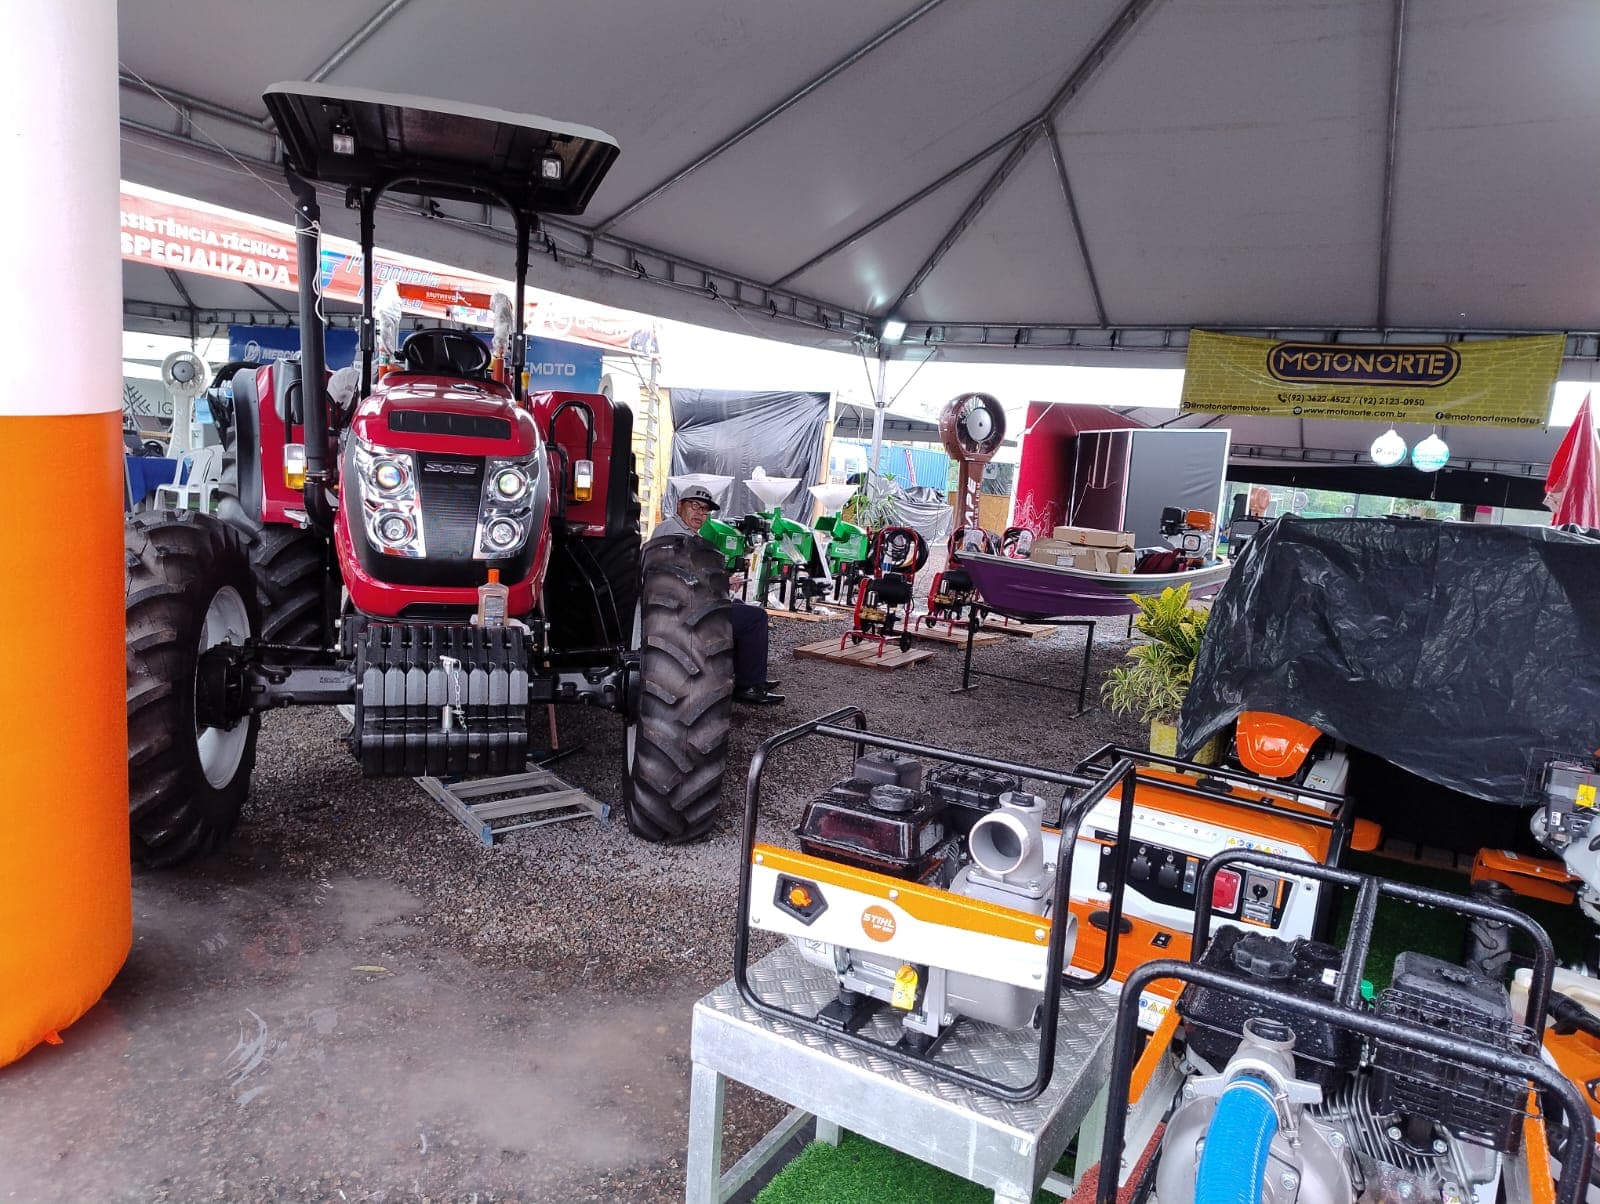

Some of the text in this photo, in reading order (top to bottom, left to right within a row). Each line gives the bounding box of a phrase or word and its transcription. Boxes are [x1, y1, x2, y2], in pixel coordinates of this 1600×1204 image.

[120, 211, 289, 262] SSISTÊNCIA TÉCNICA
[120, 231, 291, 286] SPECIALIZADA
[1279, 351, 1446, 375] MOTONORTE
[1288, 394, 1305, 404] (92)
[1359, 396, 1377, 405] (92)
[1379, 397, 1425, 406] 2123-0950
[1303, 407, 1407, 418] www.motonorte.com.br
[863, 912, 895, 929] STIHL
